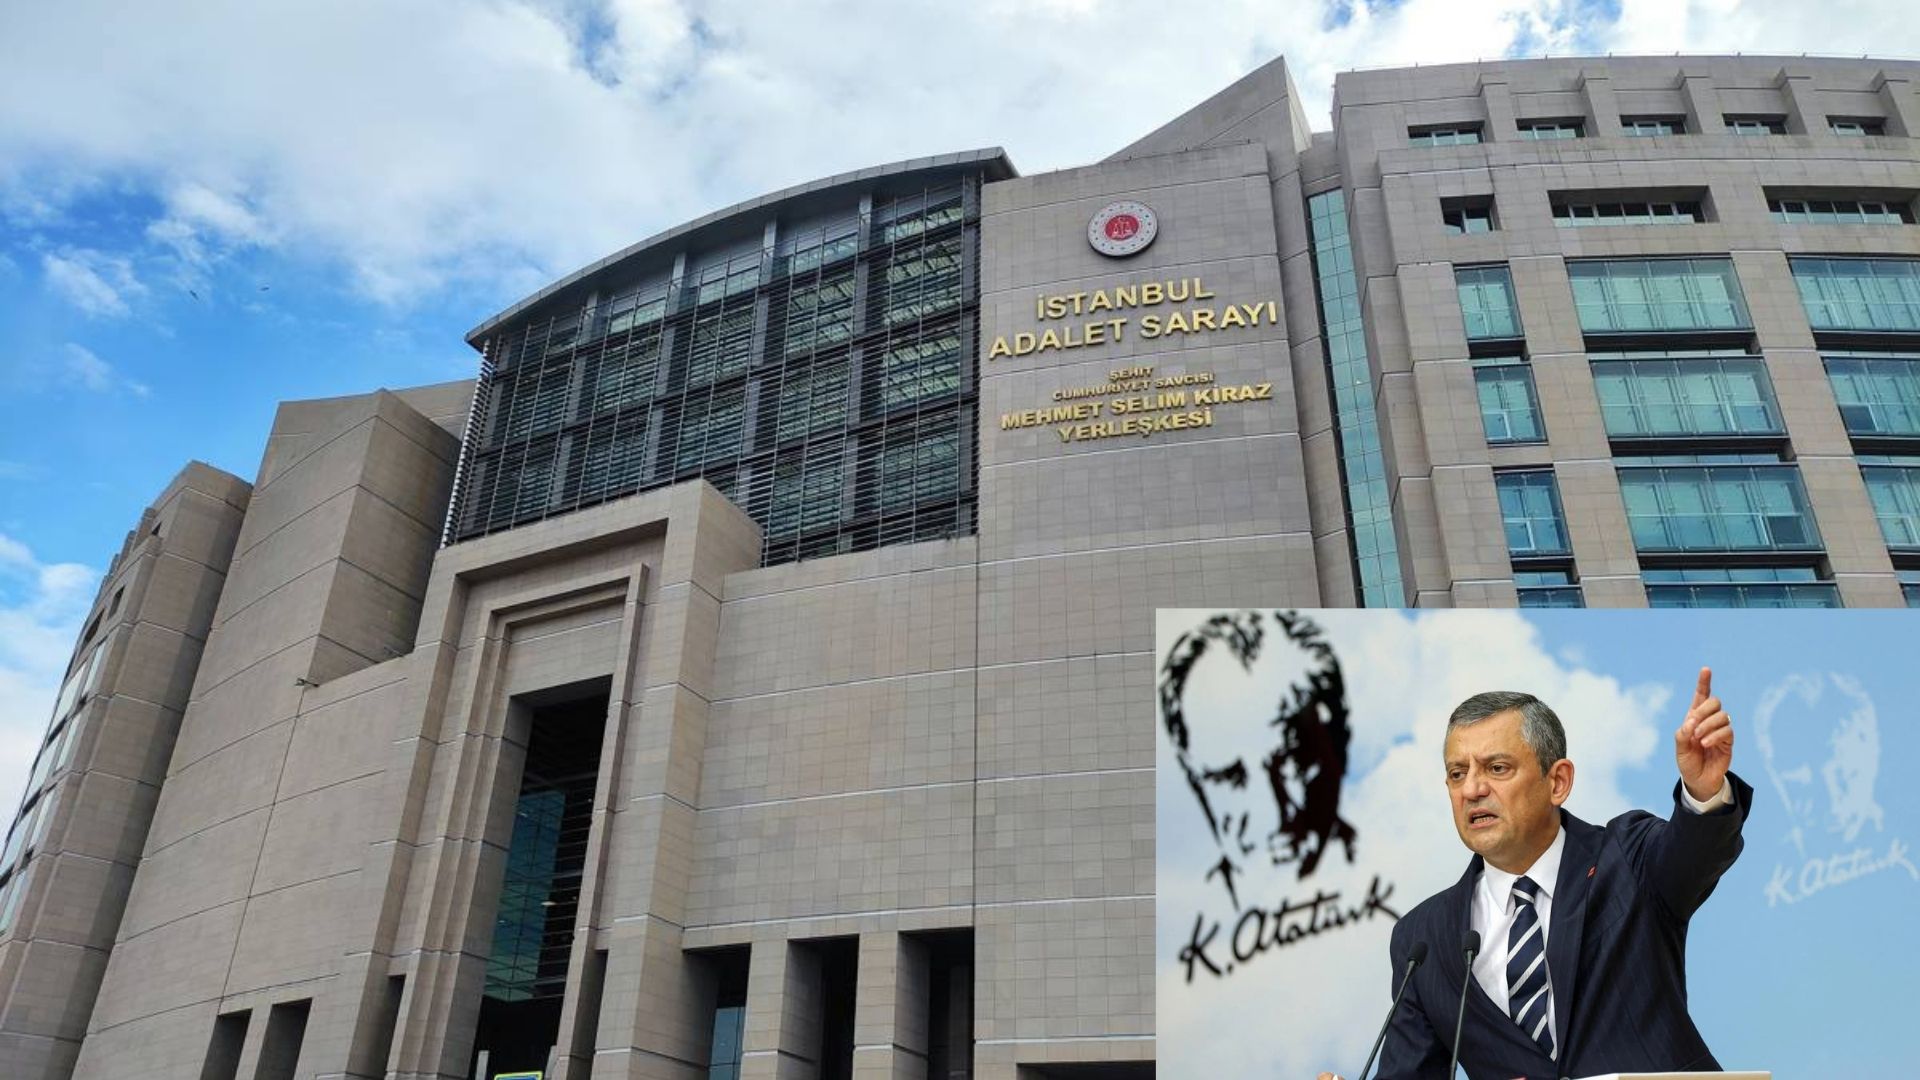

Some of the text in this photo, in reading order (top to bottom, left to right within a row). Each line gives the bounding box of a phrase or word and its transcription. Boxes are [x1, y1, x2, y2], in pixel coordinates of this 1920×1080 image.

[1037, 278, 1215, 321] İSTANBUL
[989, 301, 1279, 359] ADALET SARAYI
[1001, 401, 1104, 431] MEHMET
[1057, 407, 1213, 443] YERLEŞKESİ
